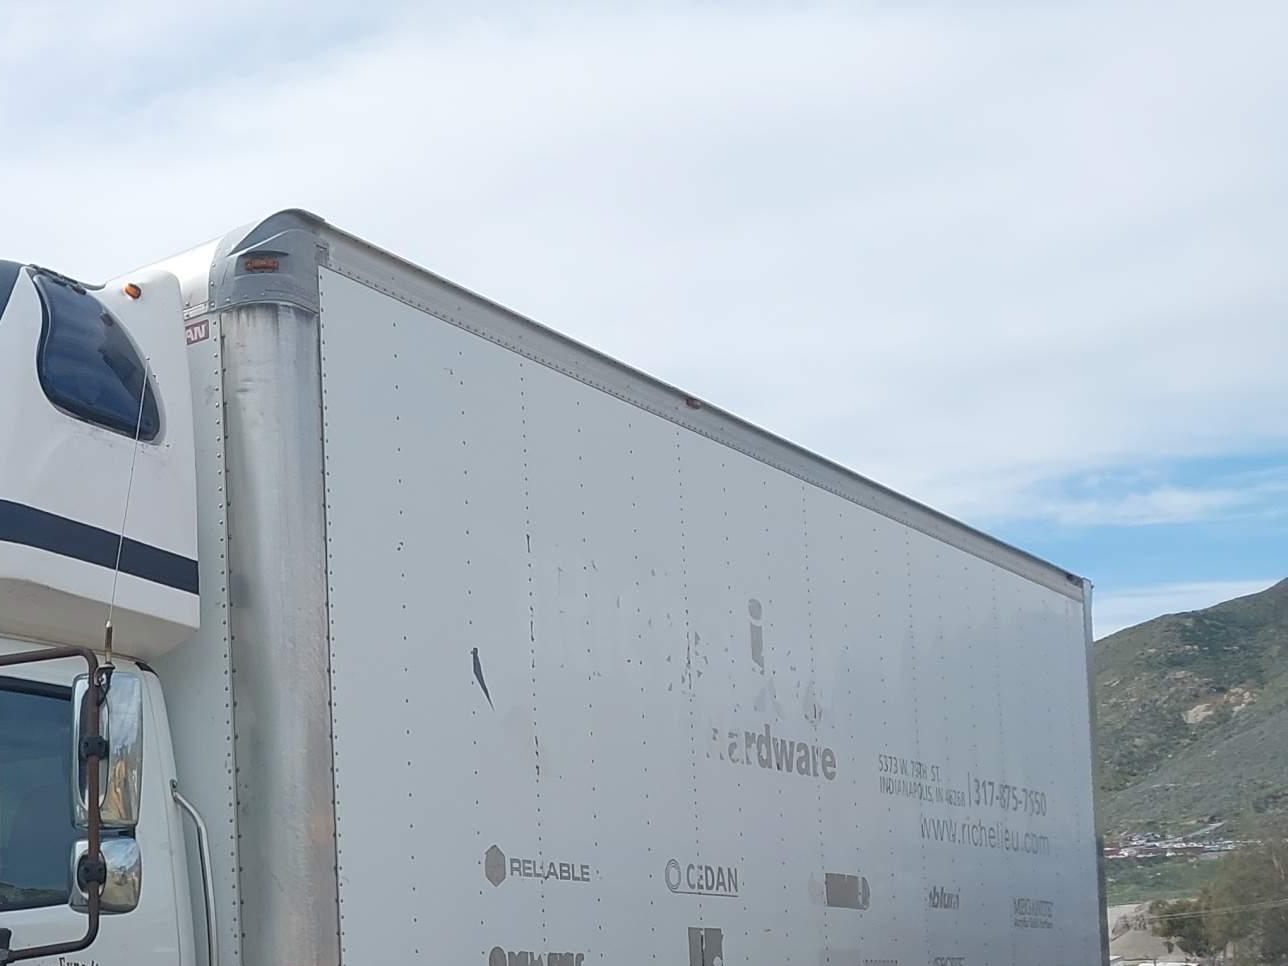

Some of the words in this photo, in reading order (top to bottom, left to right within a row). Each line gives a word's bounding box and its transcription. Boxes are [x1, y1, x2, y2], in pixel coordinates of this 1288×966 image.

[712, 724, 837, 781] ardware
[920, 817, 1050, 856] www.richelieu.com
[509, 858, 591, 882] RELABLE
